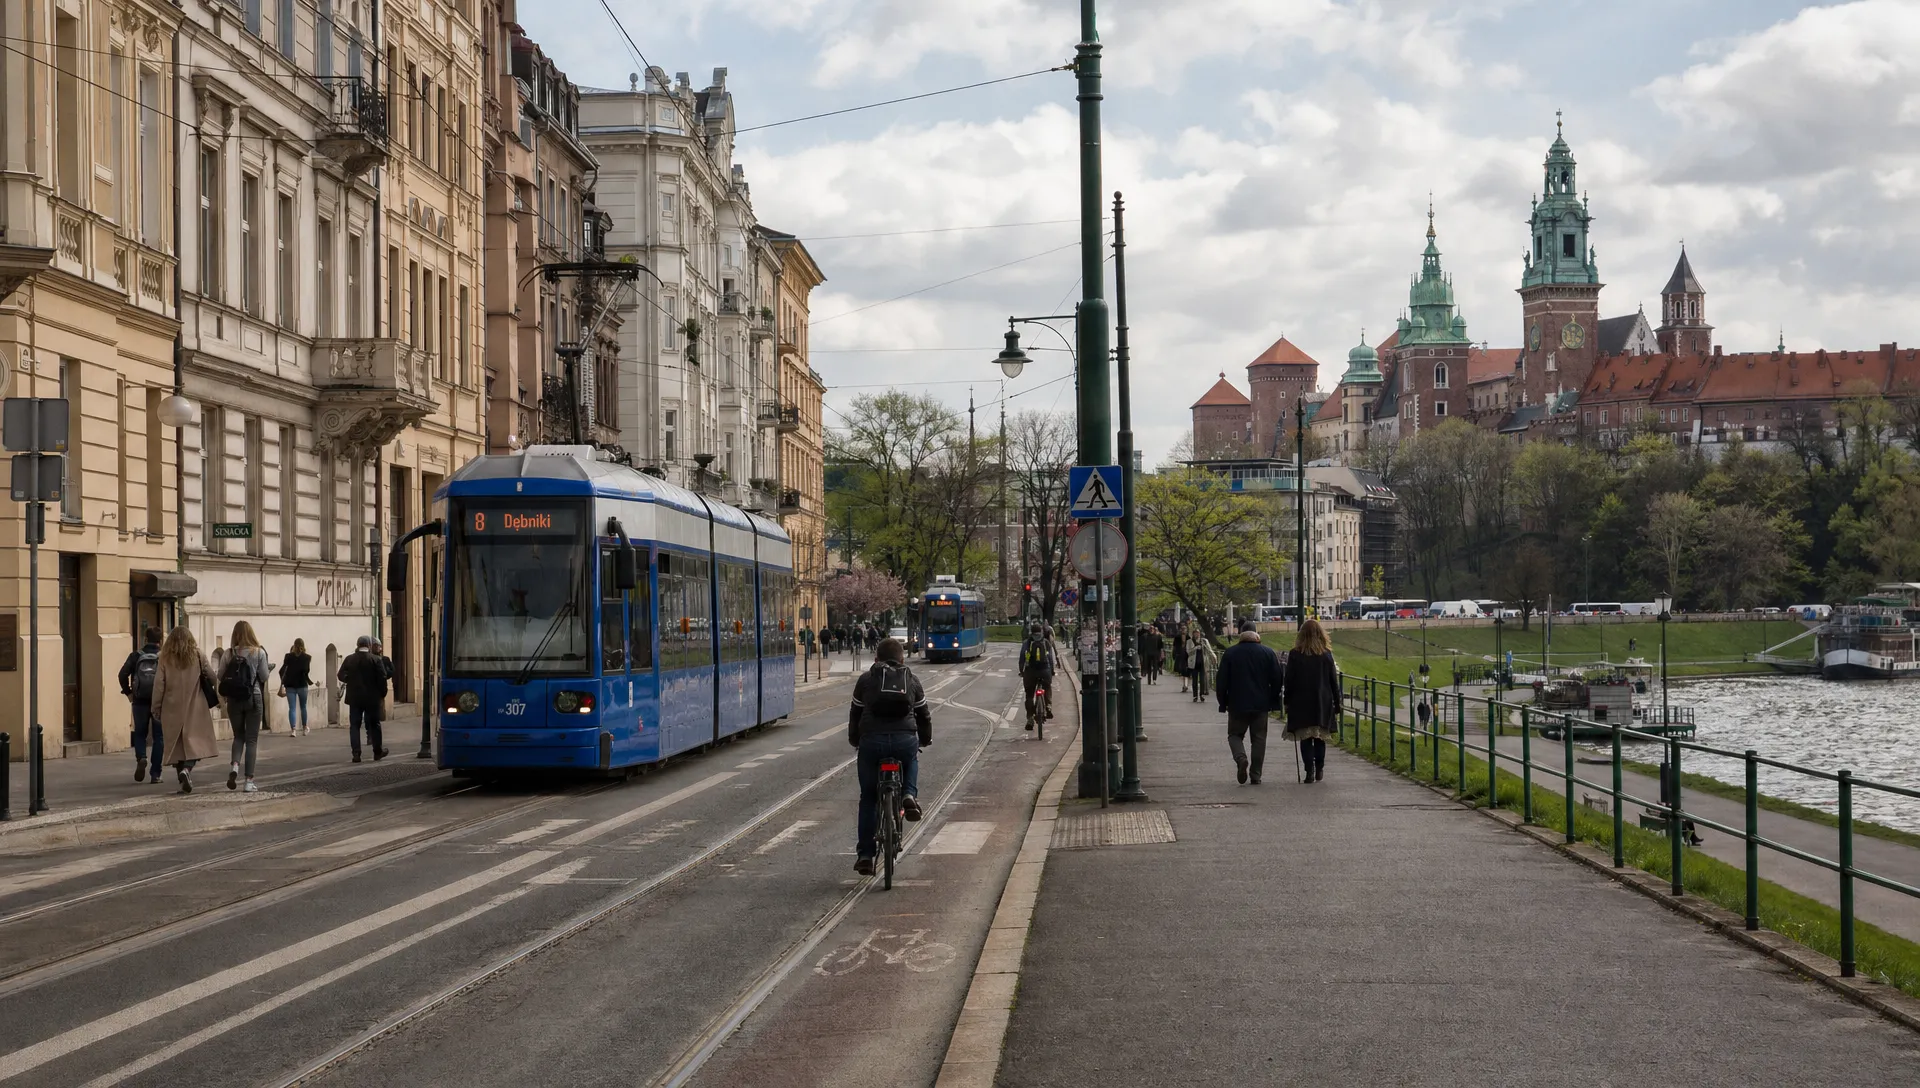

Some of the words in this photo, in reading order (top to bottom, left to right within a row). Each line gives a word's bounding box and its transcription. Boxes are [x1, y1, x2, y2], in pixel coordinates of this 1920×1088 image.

[475, 512, 485, 531] 8
[504, 513, 551, 532] Dębniki
[505, 703, 526, 716] 307
